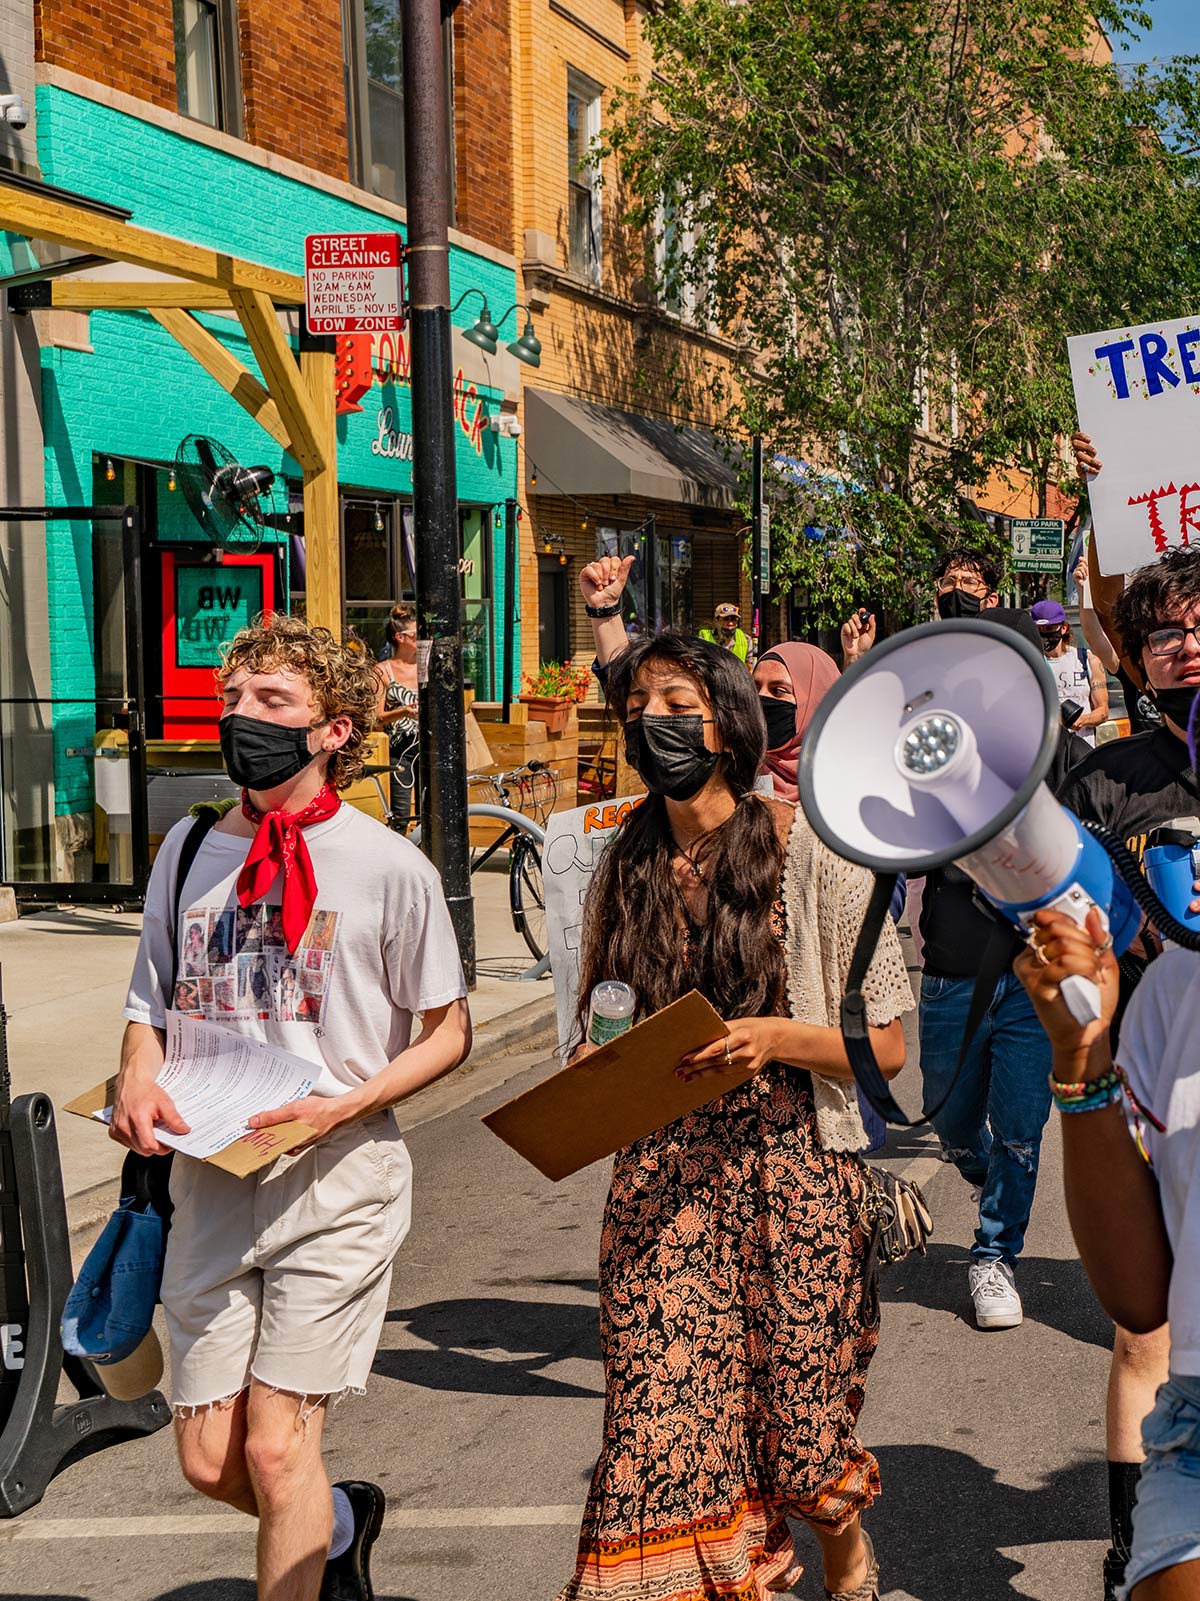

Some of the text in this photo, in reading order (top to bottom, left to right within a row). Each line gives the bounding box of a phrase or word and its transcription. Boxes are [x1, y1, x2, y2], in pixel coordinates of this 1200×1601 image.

[312, 238, 367, 251] STREET
[312, 251, 391, 265] CLEANING
[312, 271, 375, 281] NO PARKING
[313, 293, 376, 303] WEDNESDAY
[314, 305, 343, 314] APRIL
[346, 304, 356, 314] 15
[364, 304, 385, 313] NOV
[388, 304, 397, 313] 15
[314, 317, 396, 331] TOW ZONE
